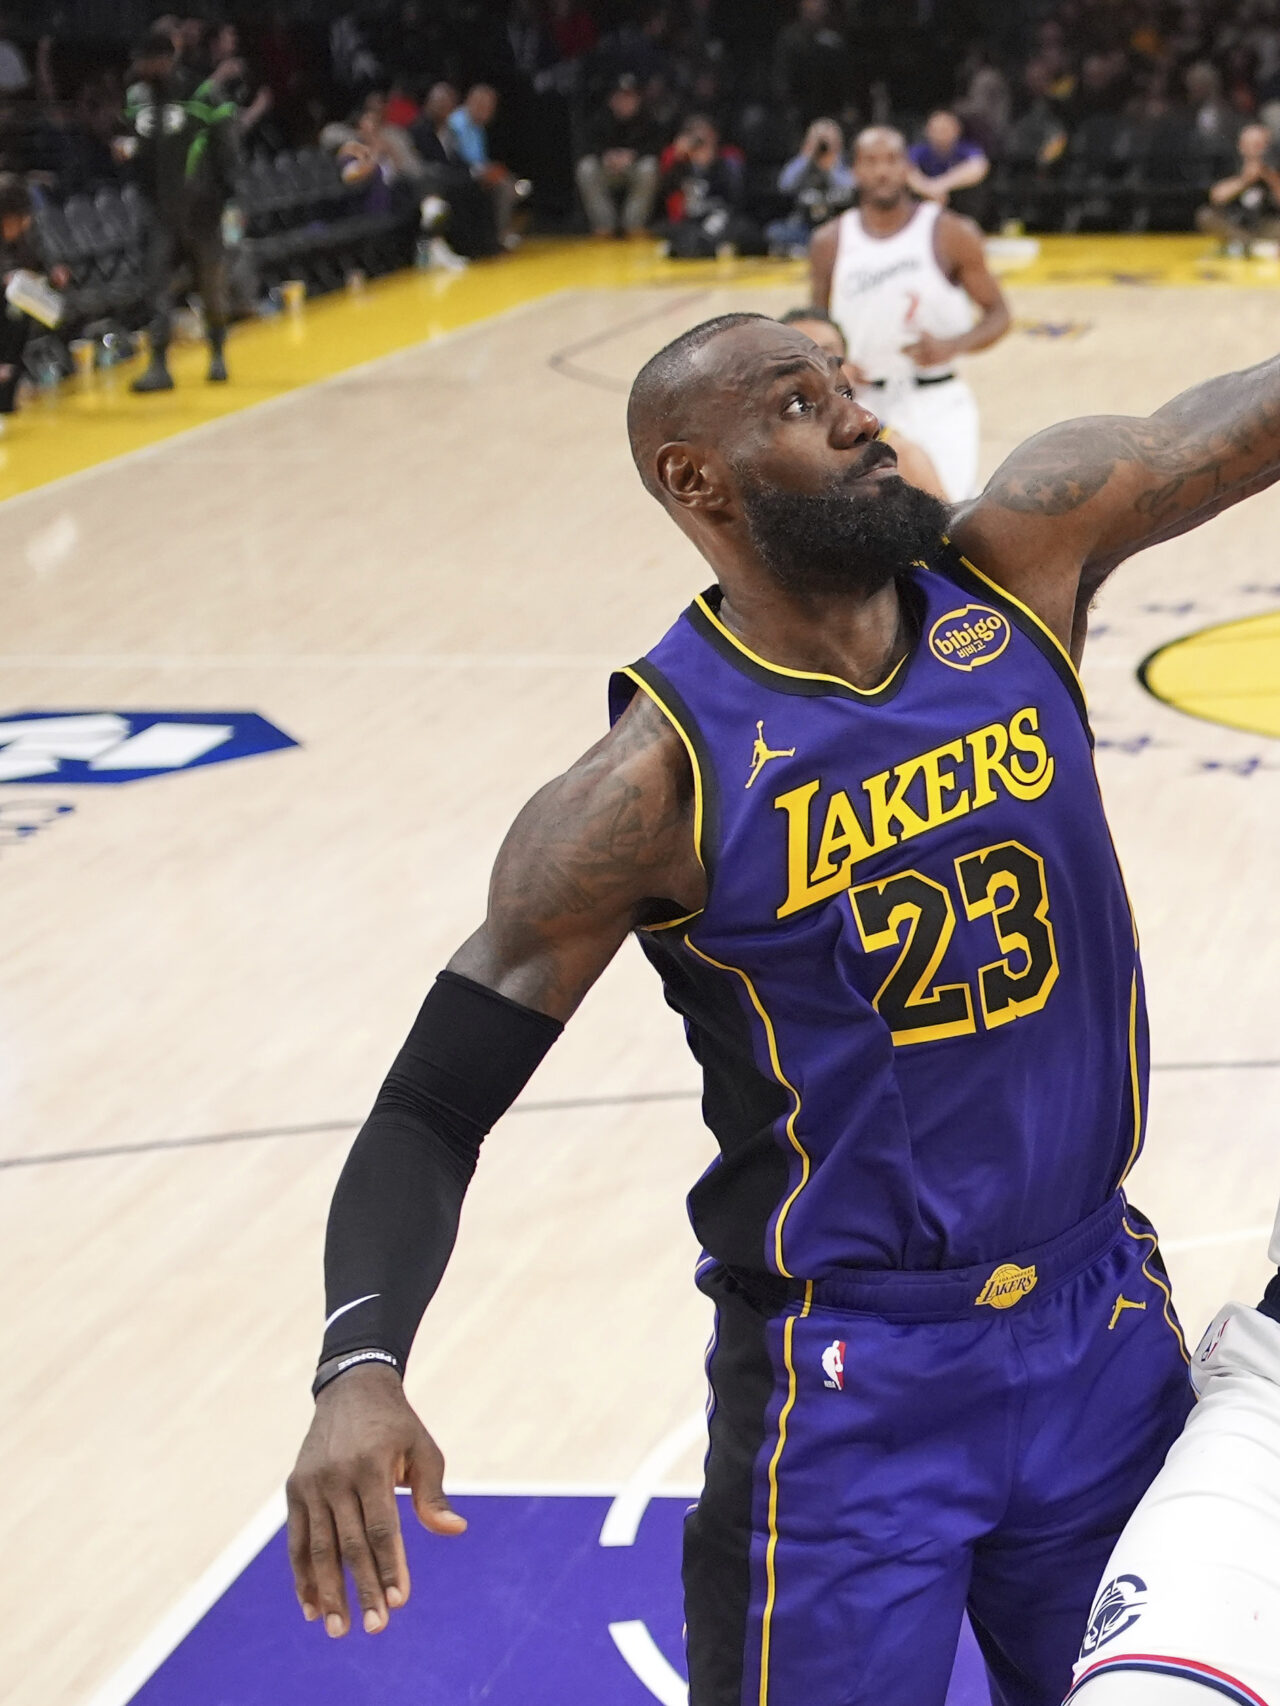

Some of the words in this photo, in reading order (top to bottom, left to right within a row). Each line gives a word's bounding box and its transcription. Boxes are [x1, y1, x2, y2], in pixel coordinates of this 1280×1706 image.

[934, 616, 1002, 655] bibigo
[956, 640, 987, 659] 비비고
[774, 706, 1056, 920] LAKERS
[848, 839, 1060, 1047] 23
[980, 1273, 1036, 1303] LAKERS
